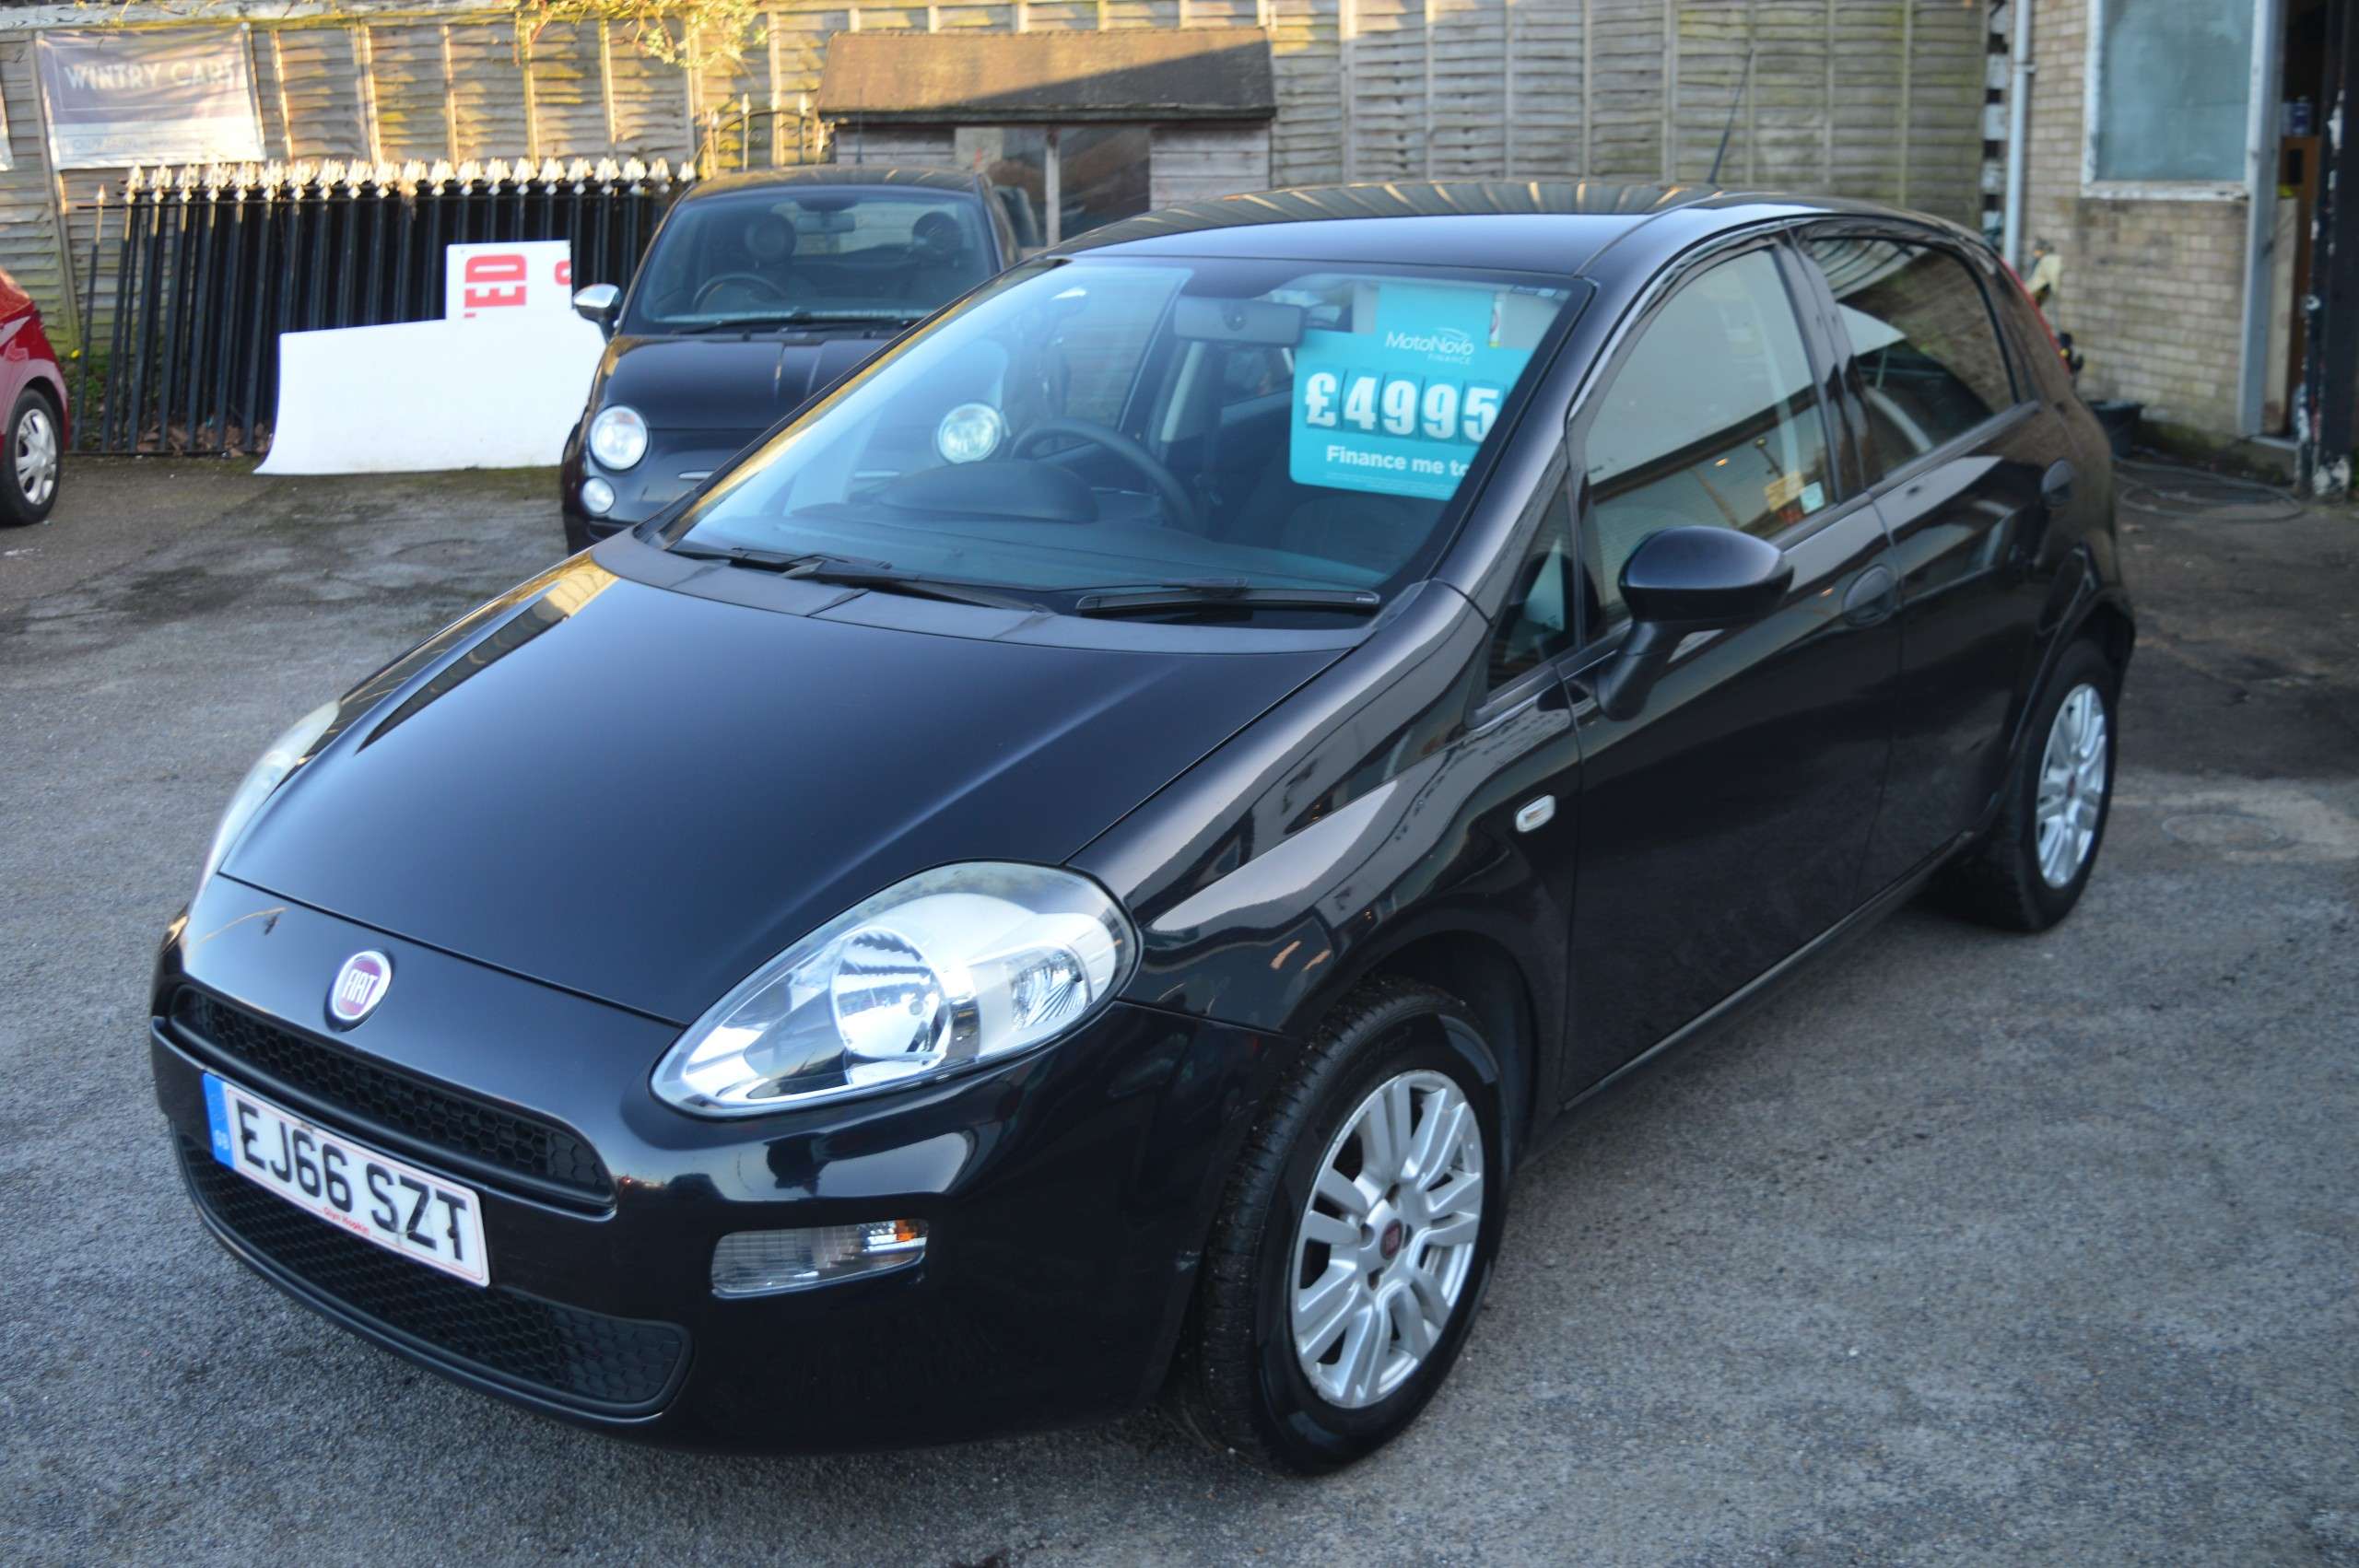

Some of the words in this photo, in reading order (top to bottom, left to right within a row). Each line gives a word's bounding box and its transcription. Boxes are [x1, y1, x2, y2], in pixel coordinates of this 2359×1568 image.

[64, 62, 161, 89] WINTRY
[464, 253, 527, 319] ED
[1384, 330, 1474, 357] MotoNovo
[1305, 371, 1500, 443] £4995
[1326, 444, 1406, 471] Finance
[1411, 458, 1445, 475] me
[341, 967, 379, 1005] FIAT
[236, 1099, 352, 1213] EJ66
[366, 1163, 467, 1261] SZT
